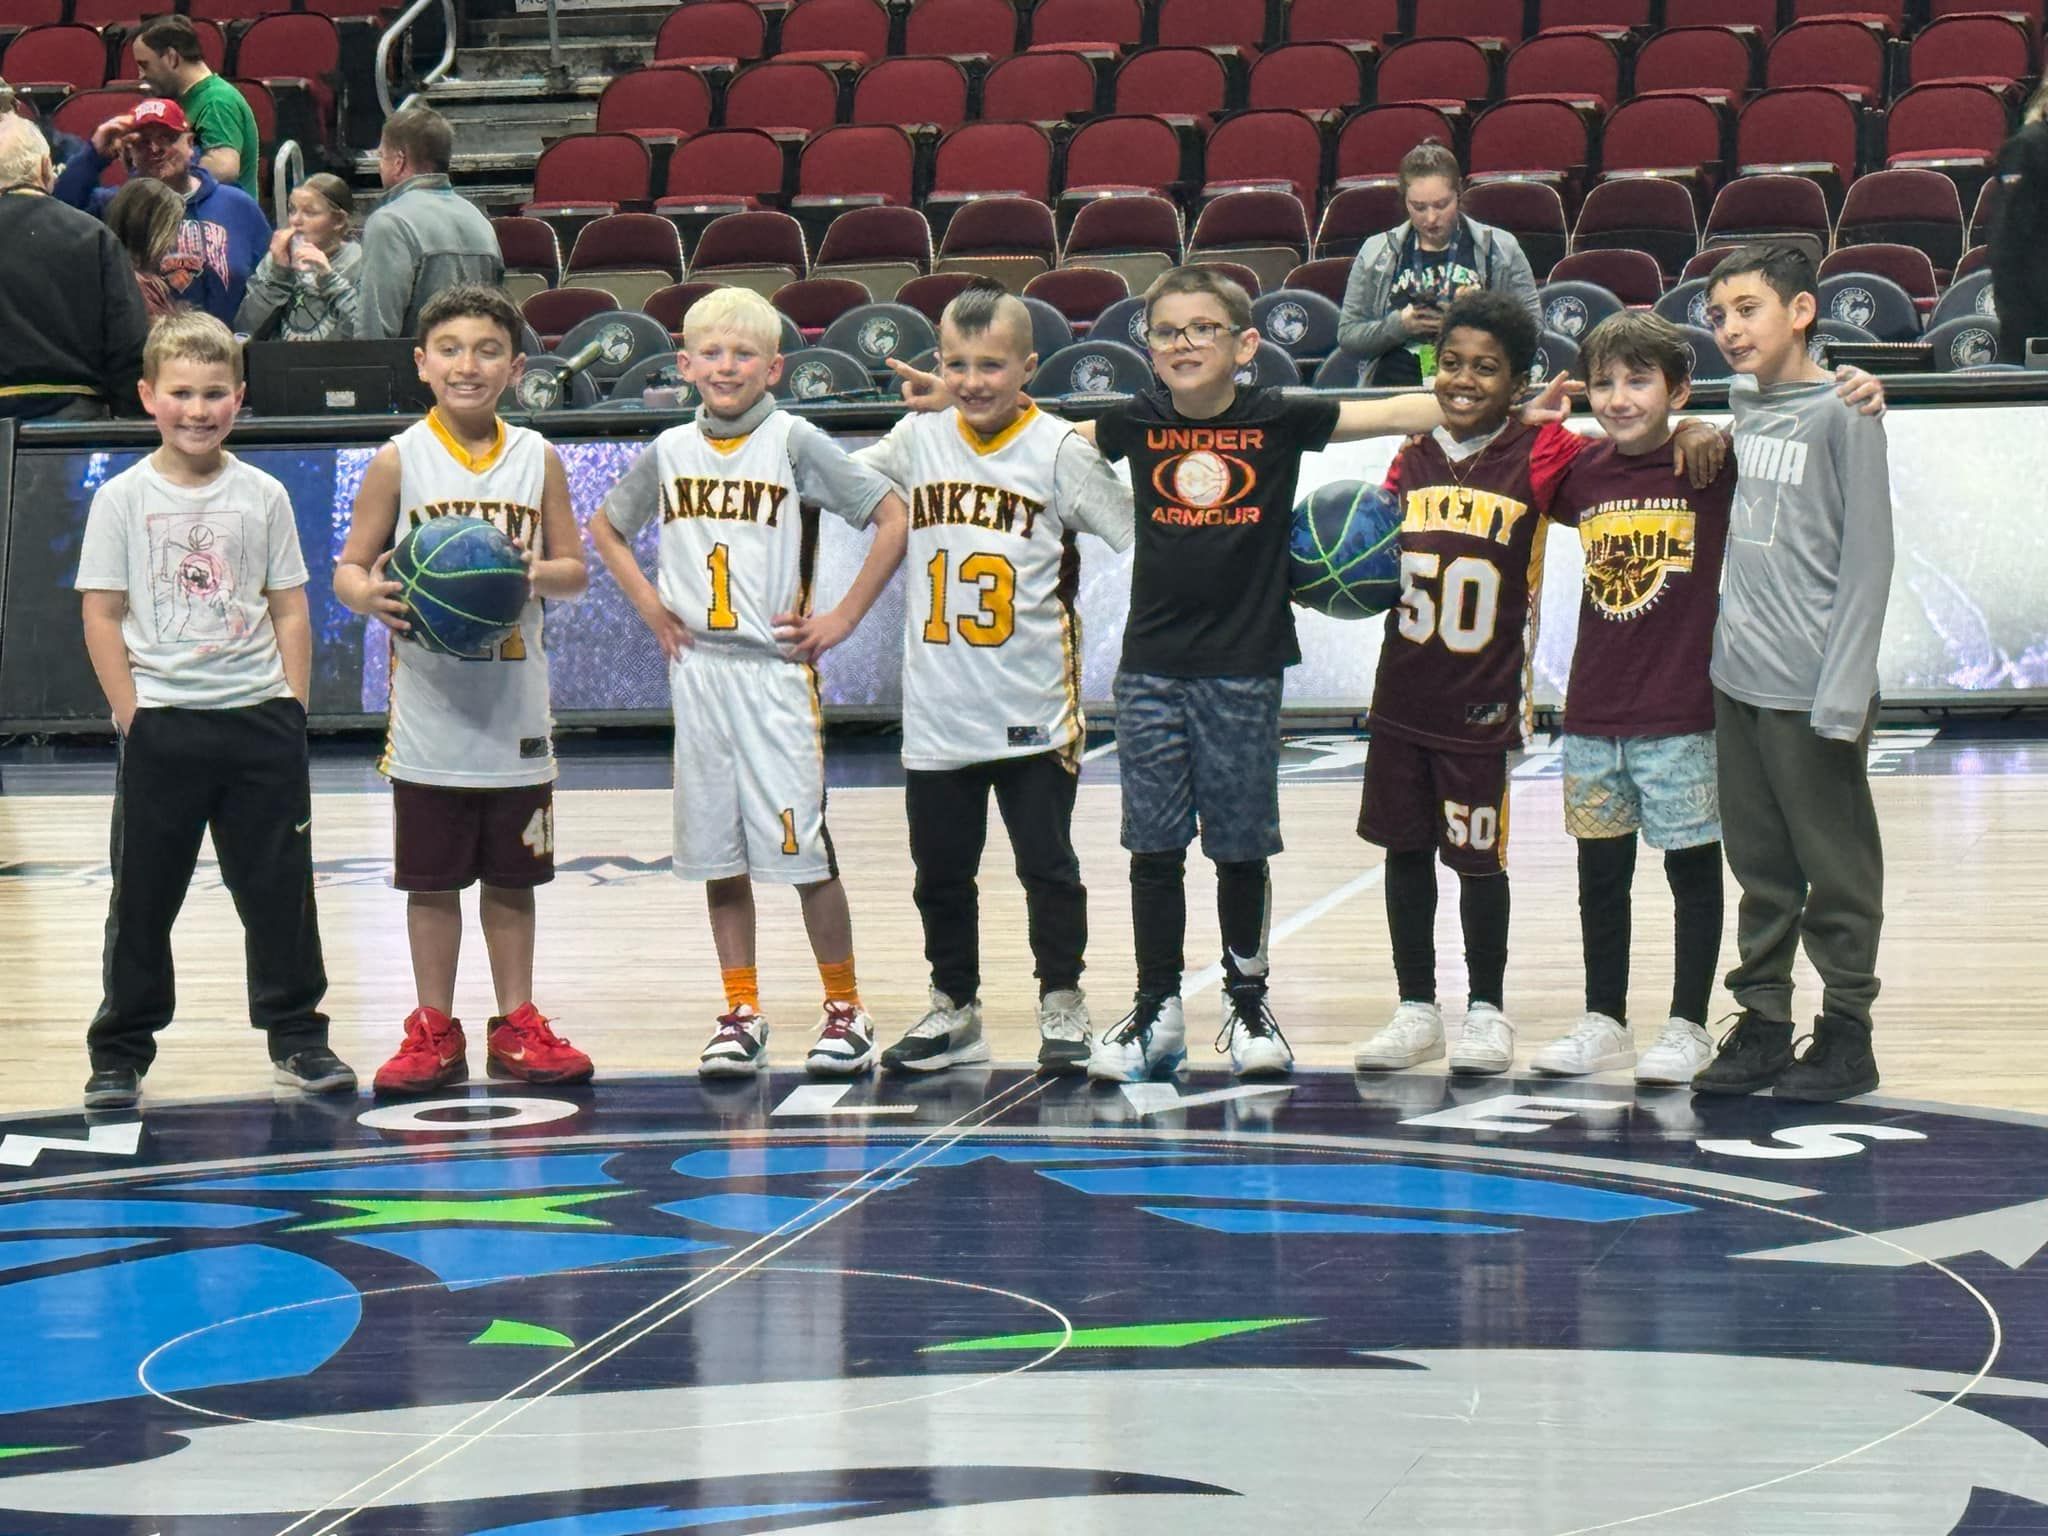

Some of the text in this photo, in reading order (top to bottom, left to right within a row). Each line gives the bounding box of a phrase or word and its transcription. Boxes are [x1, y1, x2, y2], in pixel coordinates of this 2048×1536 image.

[1146, 427, 1265, 451] UNDER
[1739, 434, 1808, 486] UMA
[911, 480, 1047, 539] ANKENY
[1151, 506, 1262, 527] ARMOUR
[1400, 484, 1528, 546] NKENY
[706, 541, 739, 632] 1
[923, 548, 1017, 648] 13
[1398, 550, 1503, 653] 50
[779, 807, 800, 856] 1
[1444, 799, 1498, 850] 50
